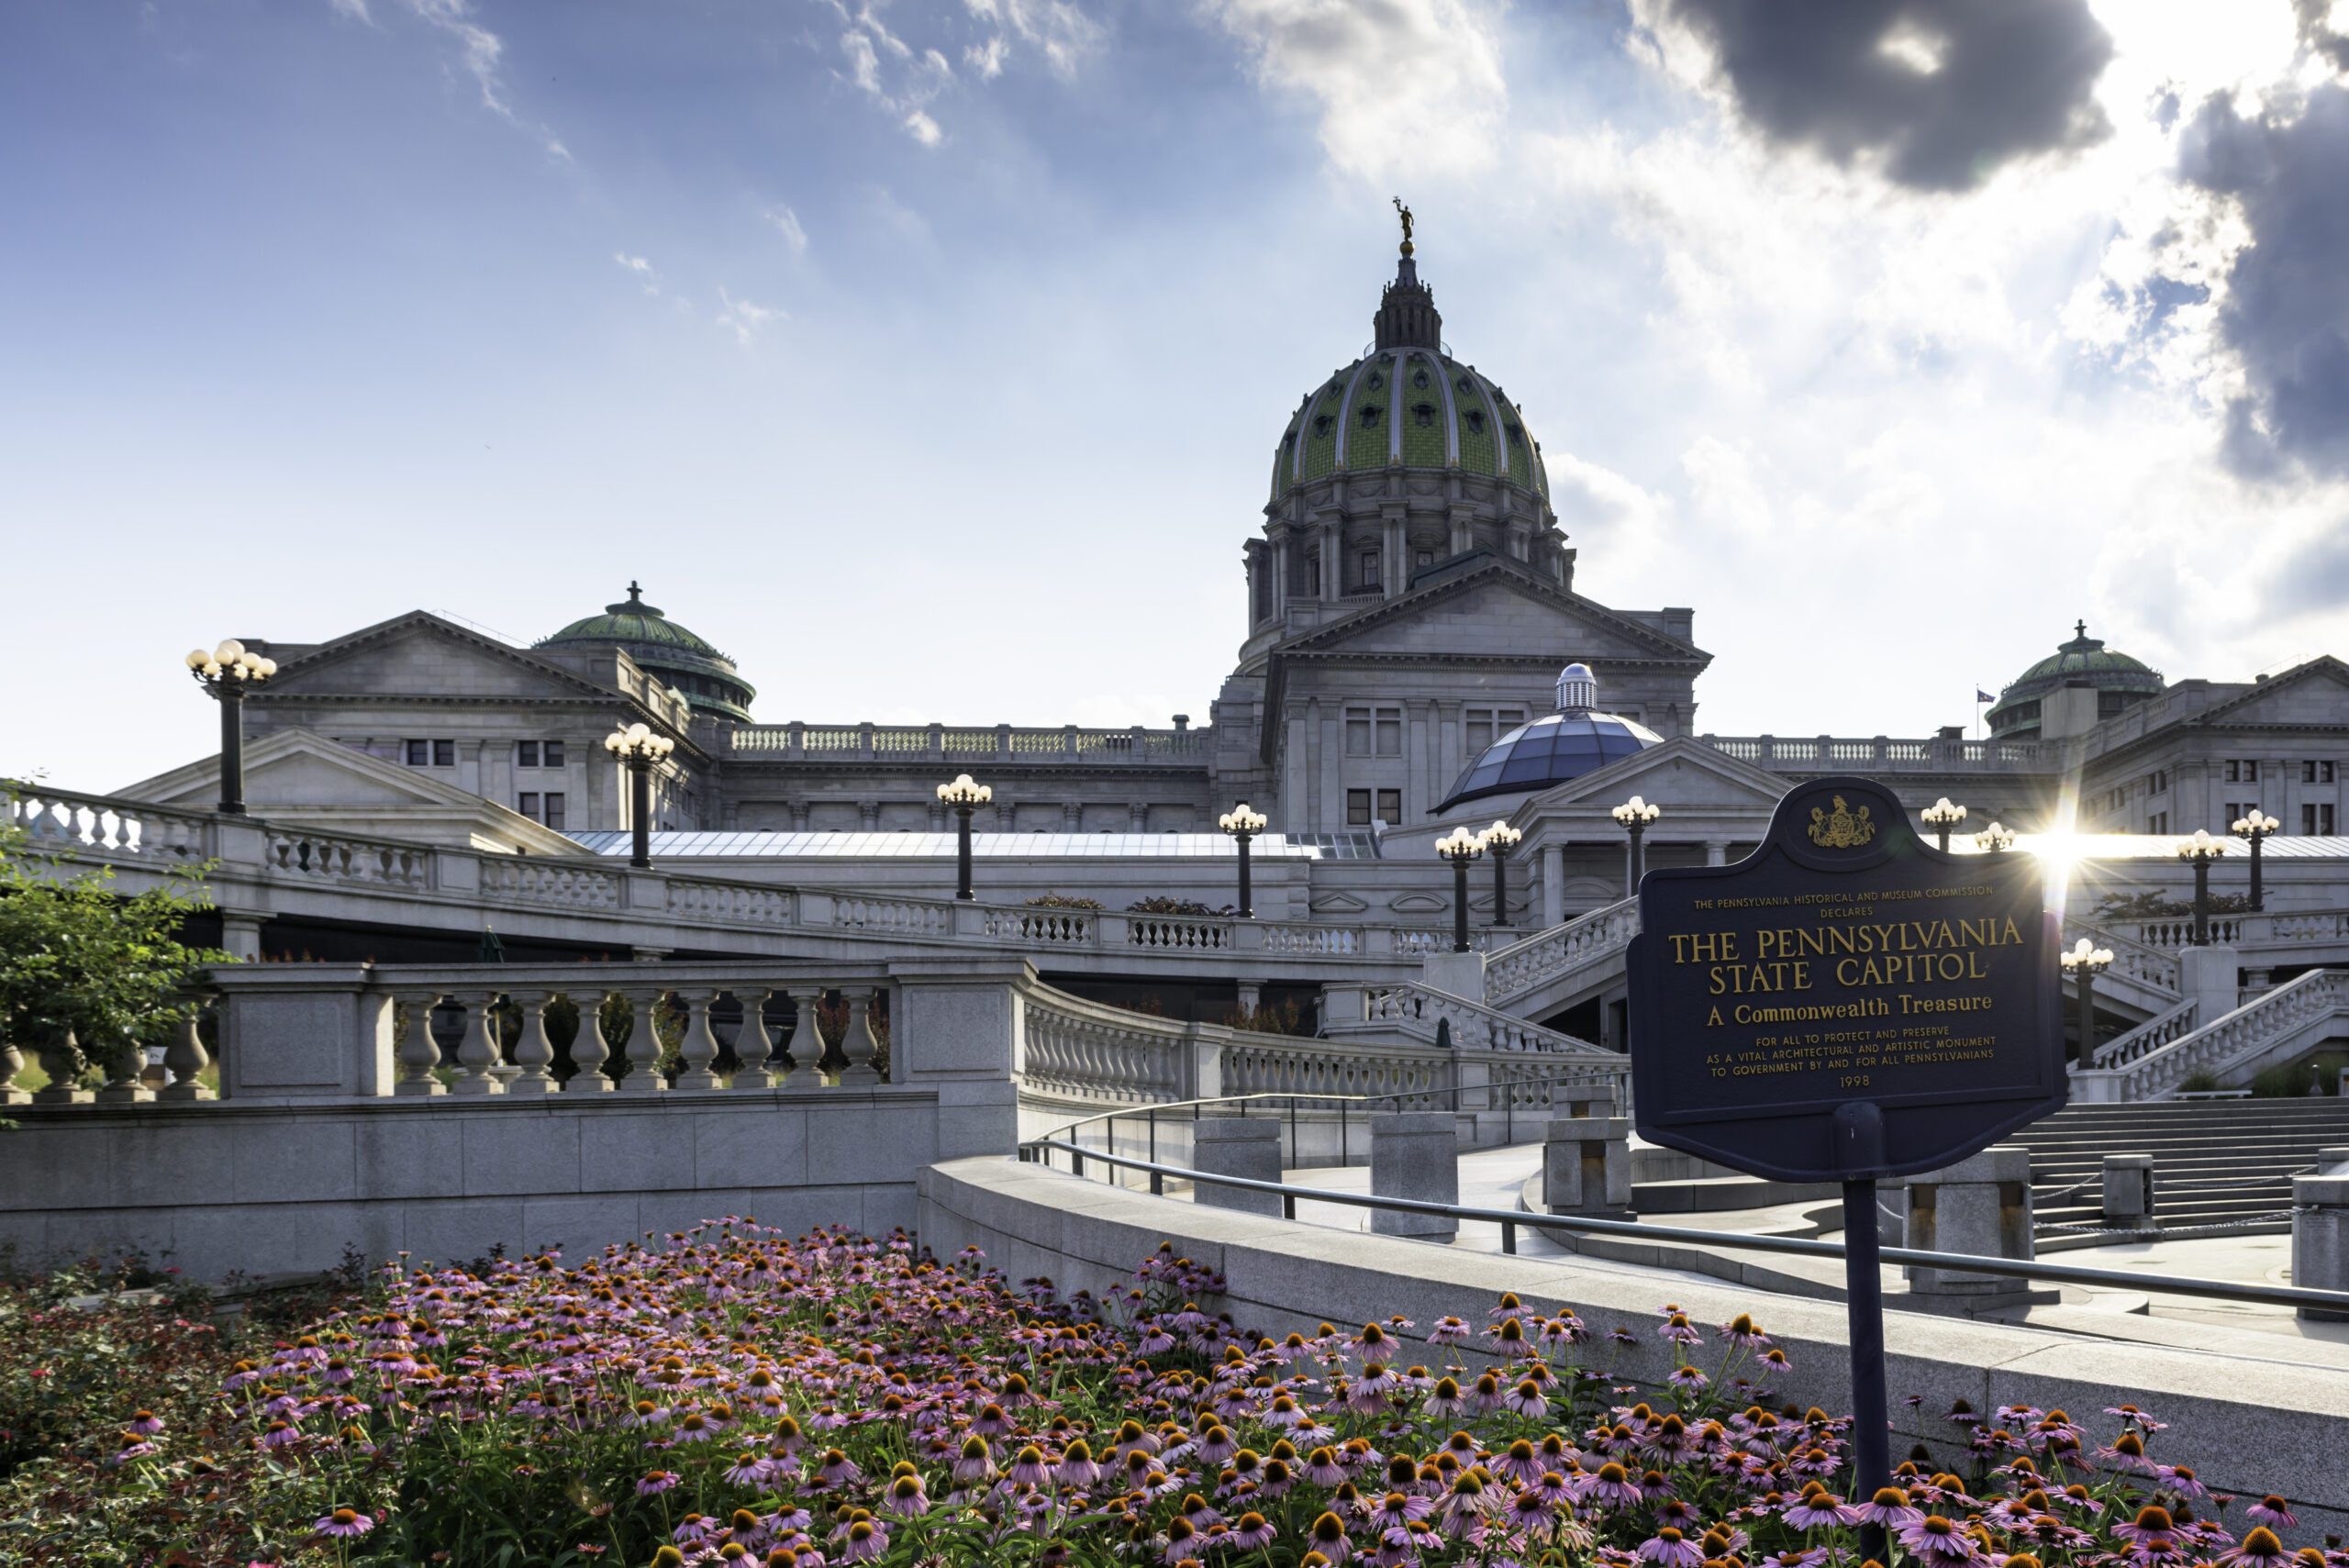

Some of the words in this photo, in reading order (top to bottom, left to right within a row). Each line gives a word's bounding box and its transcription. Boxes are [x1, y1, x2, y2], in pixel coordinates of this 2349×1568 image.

[1695, 900, 1713, 910] THE
[1718, 897, 1789, 908] PENNSYLVANIA
[1794, 894, 1854, 905] HISTORICAL
[1857, 892, 1878, 902] AND
[1882, 890, 1922, 900] MUSEUM
[1925, 886, 1994, 898] COMMISSION
[1820, 906, 1873, 917] DECLARES
[1667, 932, 1740, 963] THE
[1756, 914, 2024, 959] PENNSYLVANIA
[1709, 961, 1813, 995] STATE
[1836, 951, 1987, 986] CAPITOL
[1707, 1006, 1724, 1027] A
[1734, 997, 1890, 1024] Commonwealth
[1898, 995, 1992, 1013] Treasure
[1755, 1037, 1777, 1047] FOR
[1782, 1035, 1801, 1046] ALL
[1805, 1034, 1820, 1044] TO
[1824, 1030, 1871, 1042] PROTECT
[1876, 1029, 1897, 1040] AND
[1902, 1026, 1950, 1037] PRESERVE
[1707, 1054, 1720, 1064] AS
[1725, 1054, 1733, 1063] A
[1738, 1051, 1767, 1062] VITAL
[1772, 1046, 1854, 1059] ARCHITECTURAL
[1858, 1043, 1879, 1053] AND
[1886, 1040, 1931, 1052] ARTISTIC
[1936, 1037, 1996, 1049] MONUMENT
[1711, 1067, 1727, 1077] TO
[1732, 1062, 1804, 1076] GOVERNMENT
[1809, 1061, 1821, 1072] BY
[1828, 1059, 1849, 1070] AND
[1855, 1056, 1876, 1067] FOR
[1881, 1055, 1899, 1065] ALL
[1904, 1050, 1994, 1063] PENNSYLVANIANS
[1840, 1074, 1870, 1088] 1998
